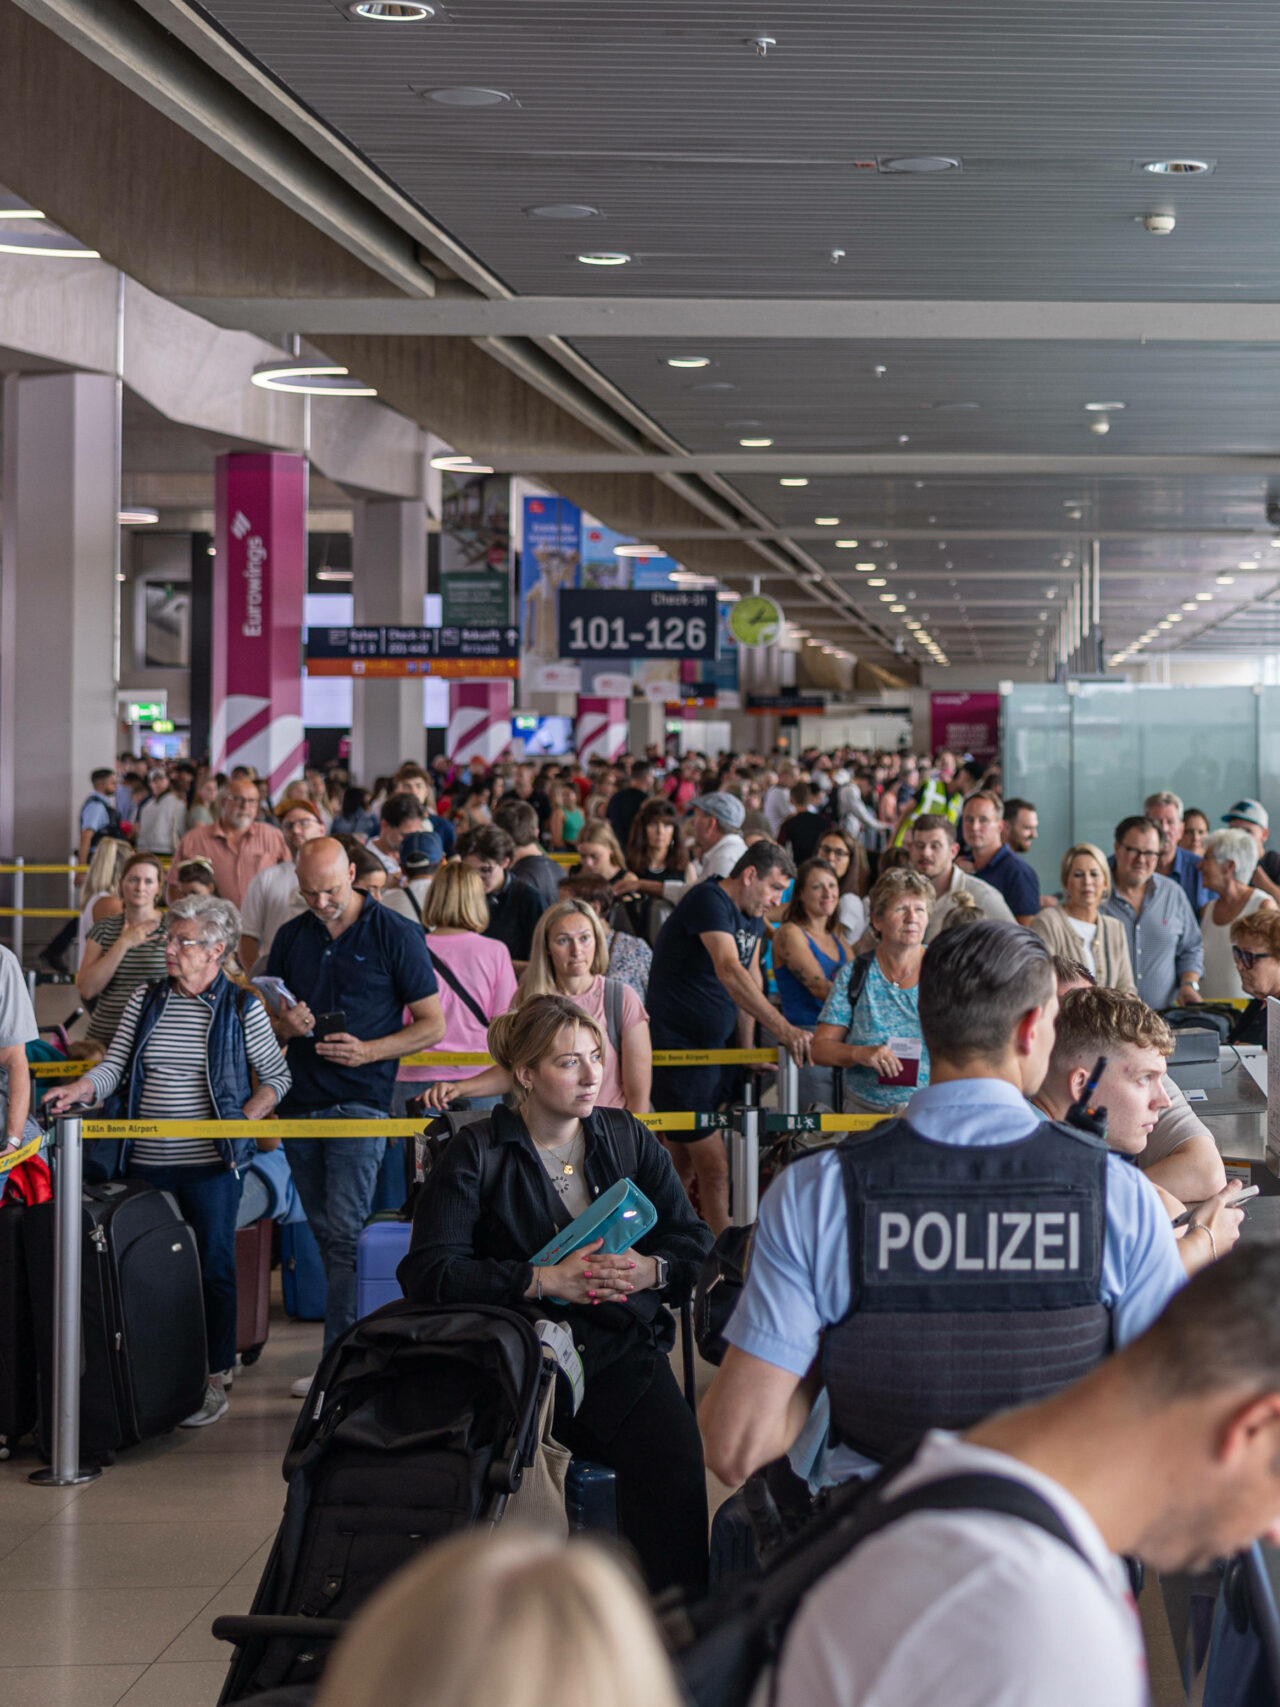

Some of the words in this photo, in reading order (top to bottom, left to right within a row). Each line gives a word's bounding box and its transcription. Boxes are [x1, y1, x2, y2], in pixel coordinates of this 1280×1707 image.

[242, 535, 267, 637] Eurowings
[651, 592, 708, 606] Check-in
[569, 616, 707, 650] 101-126
[87, 1124, 105, 1132] Köln
[107, 1124, 126, 1132] Bonn
[128, 1124, 158, 1133] Airport
[878, 1211, 1080, 1271] POLIZEI
